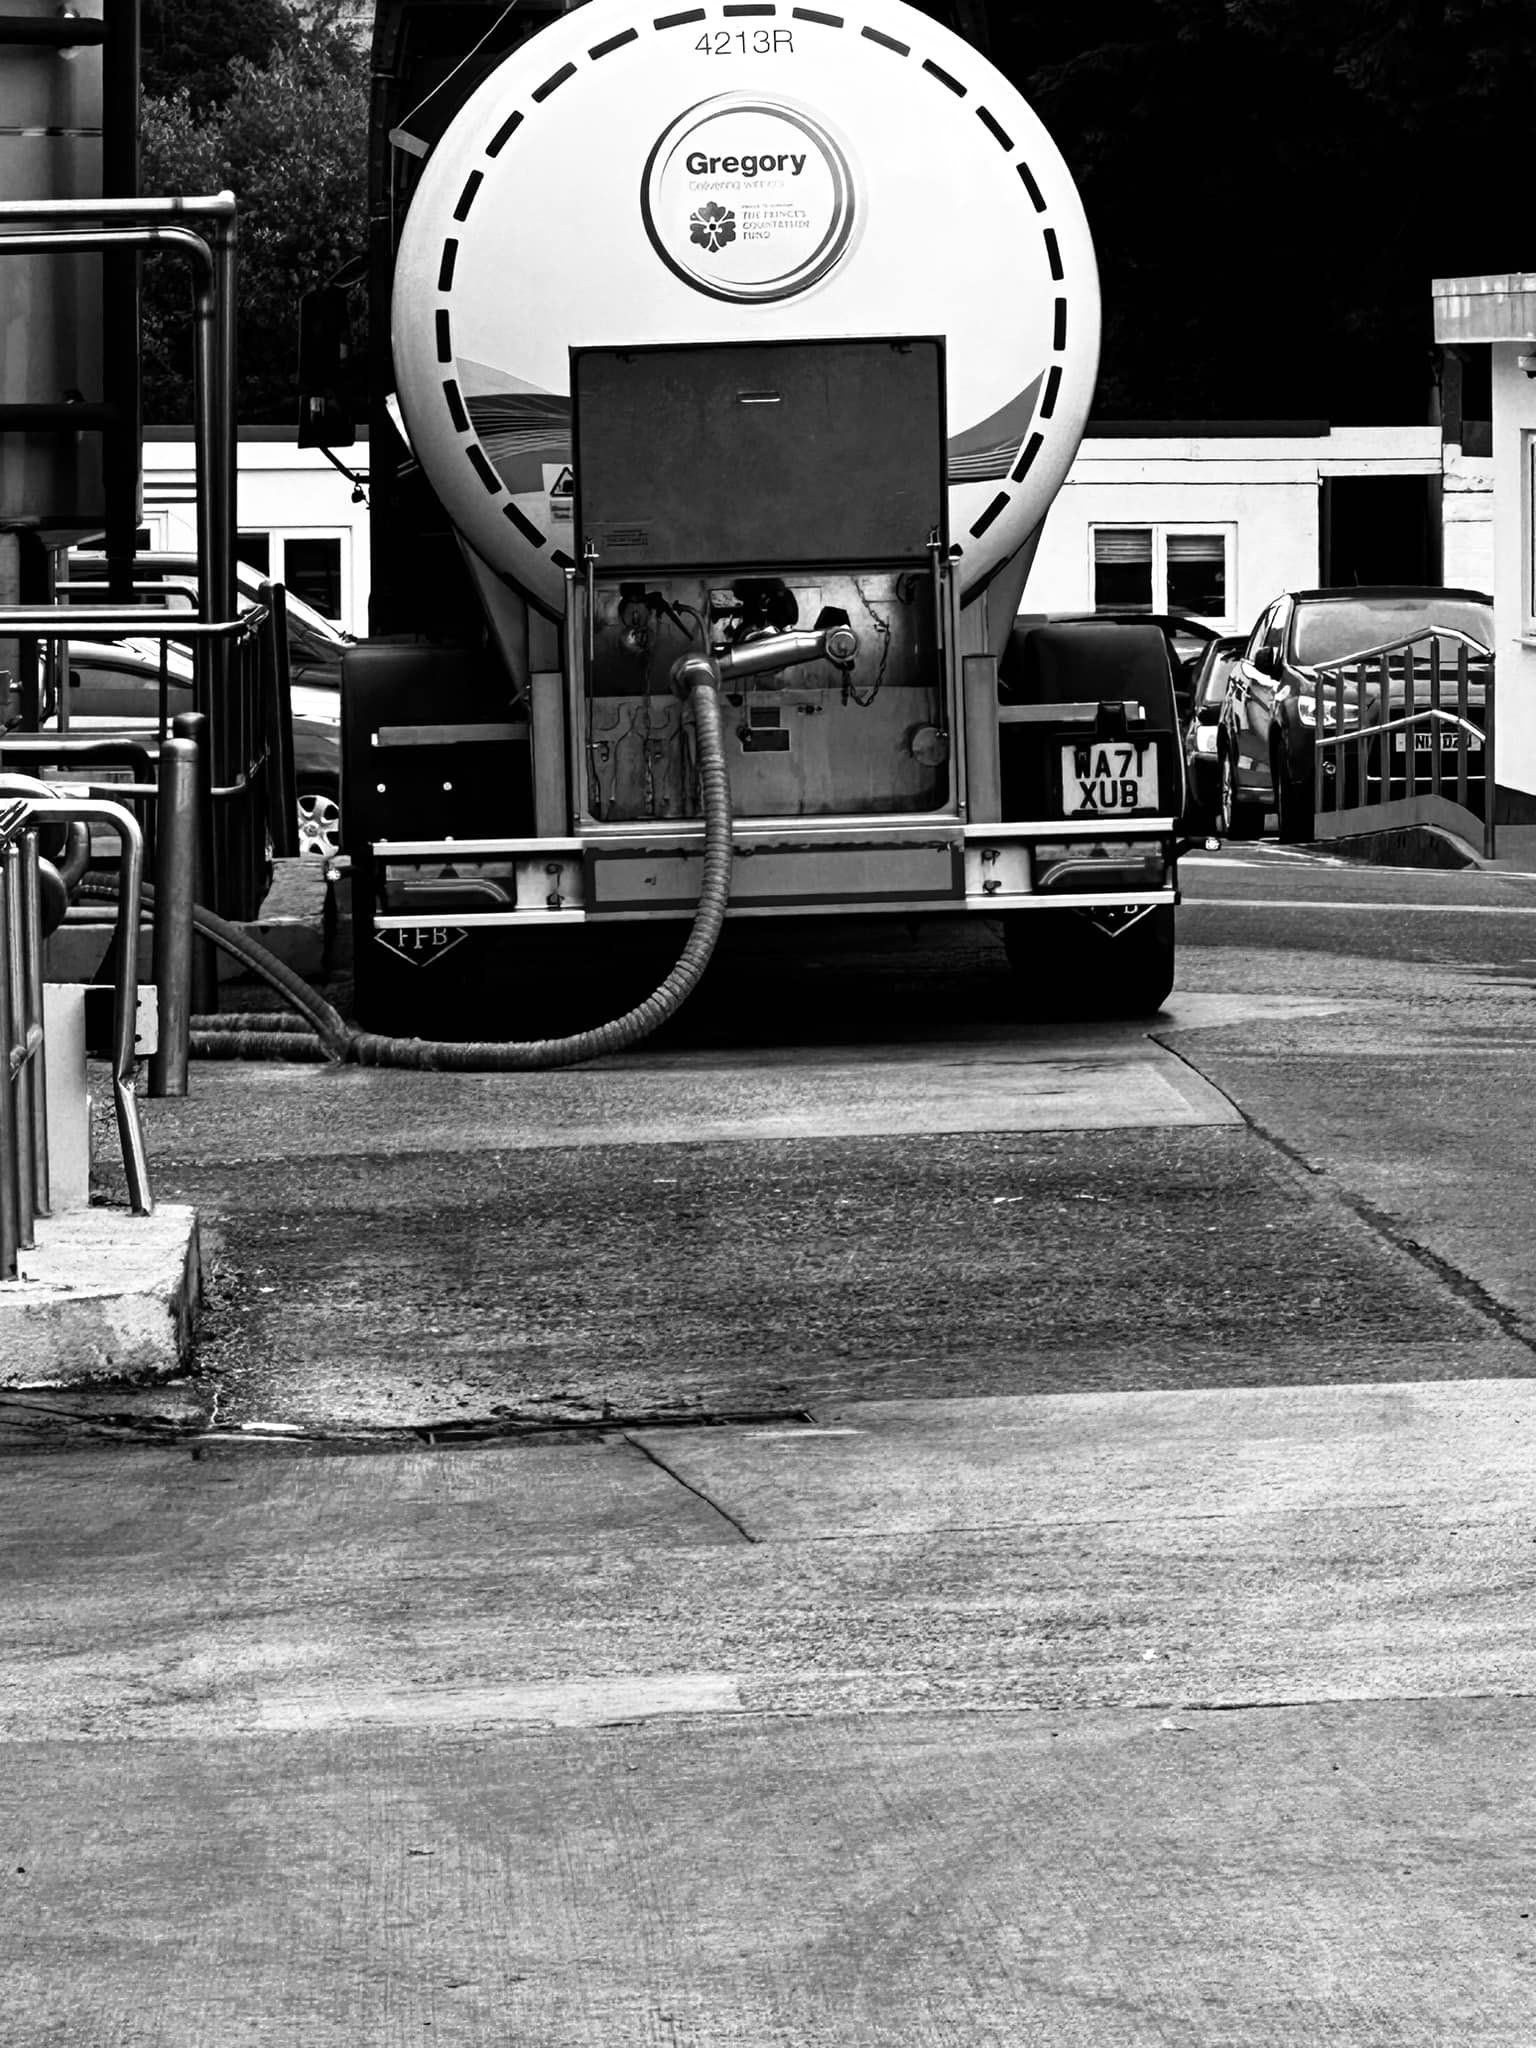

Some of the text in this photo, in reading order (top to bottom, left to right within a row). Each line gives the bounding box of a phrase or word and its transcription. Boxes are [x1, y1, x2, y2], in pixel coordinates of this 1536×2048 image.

[695, 29, 794, 55] 4213R
[685, 151, 807, 178] Gregory
[1079, 780, 1138, 809] XUB
